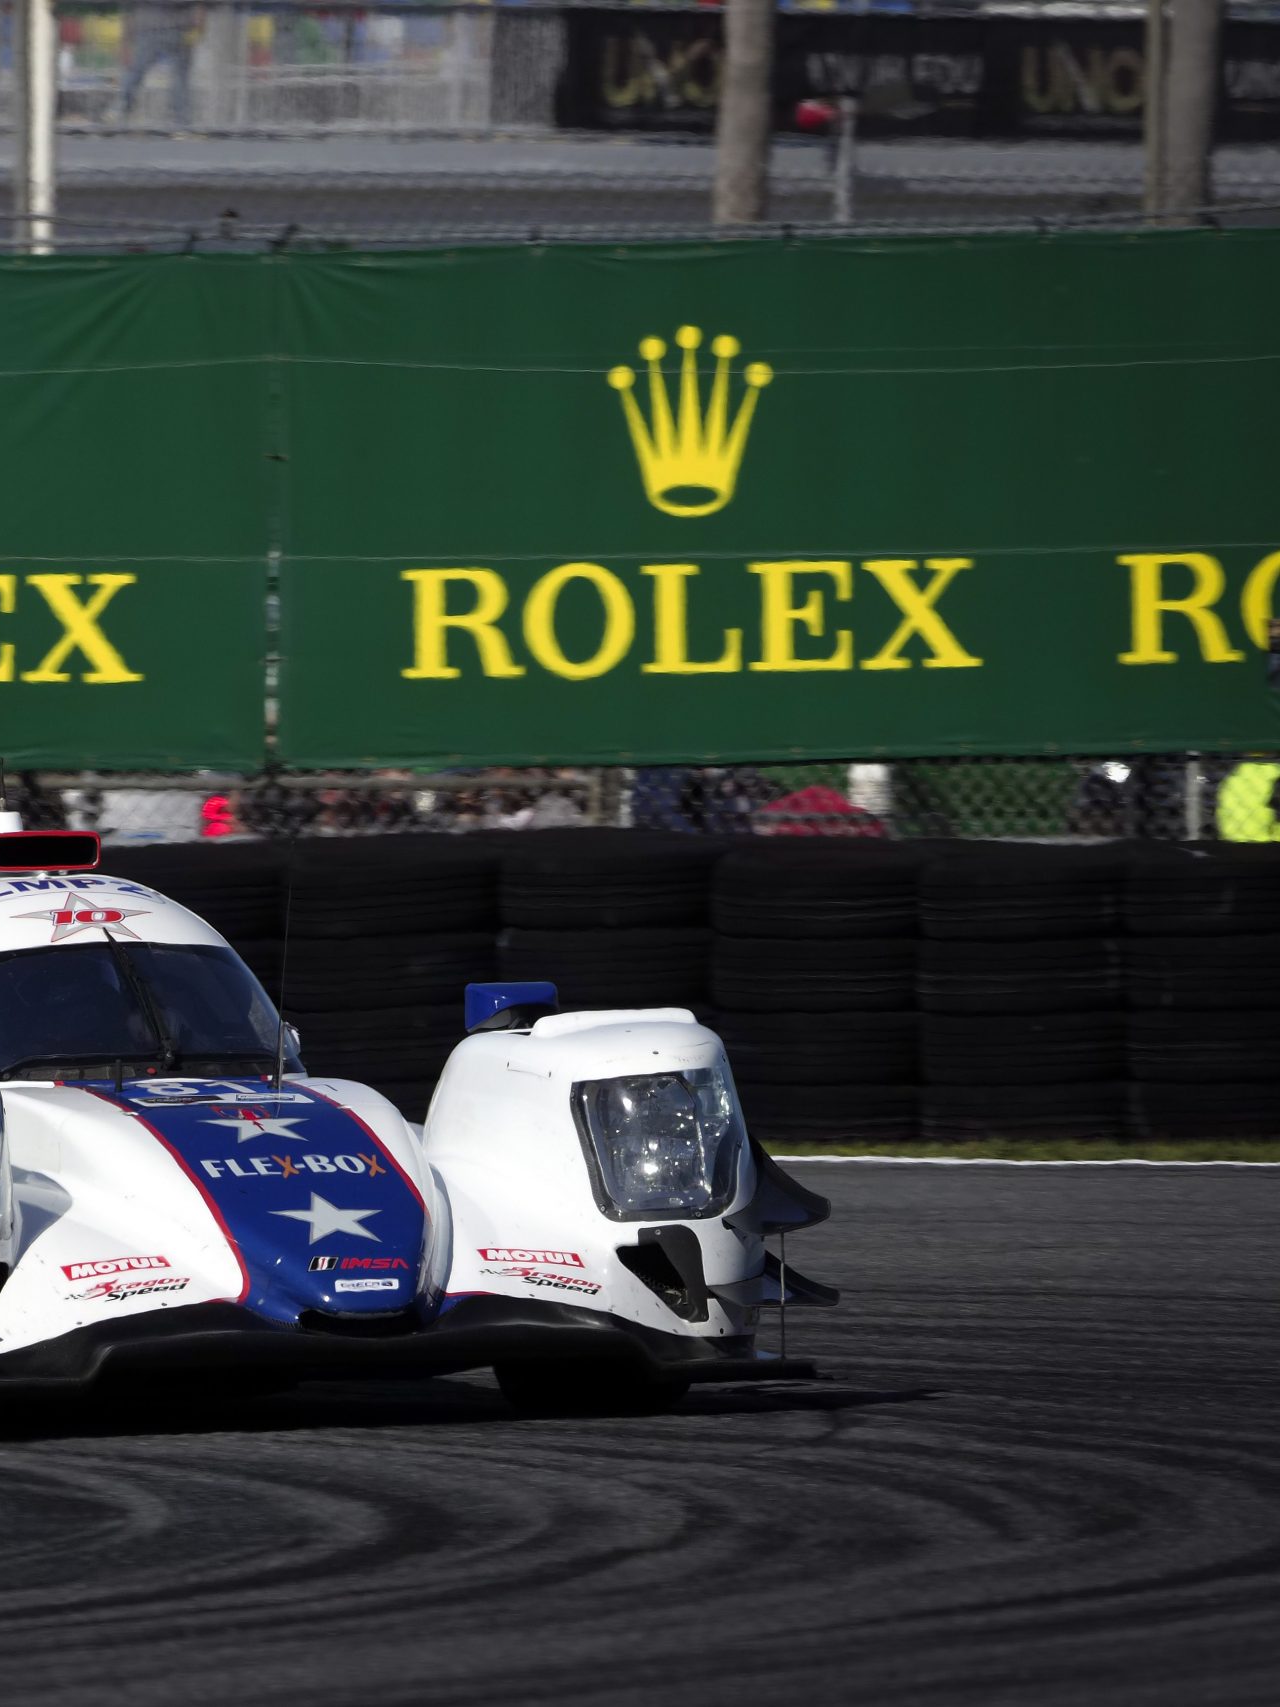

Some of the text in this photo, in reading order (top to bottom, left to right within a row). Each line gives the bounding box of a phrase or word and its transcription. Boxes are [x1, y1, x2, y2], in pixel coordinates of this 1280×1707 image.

[400, 556, 984, 680] ROLEX
[51, 909, 125, 926] 10
[135, 1080, 257, 1096] 81
[200, 1153, 387, 1179] FLEX-BOX
[340, 1257, 409, 1270] IMSA
[486, 1249, 581, 1265] MOTUL
[70, 1256, 166, 1279] MOTUL
[104, 1283, 188, 1302] Speed
[521, 1276, 600, 1296] Speed
